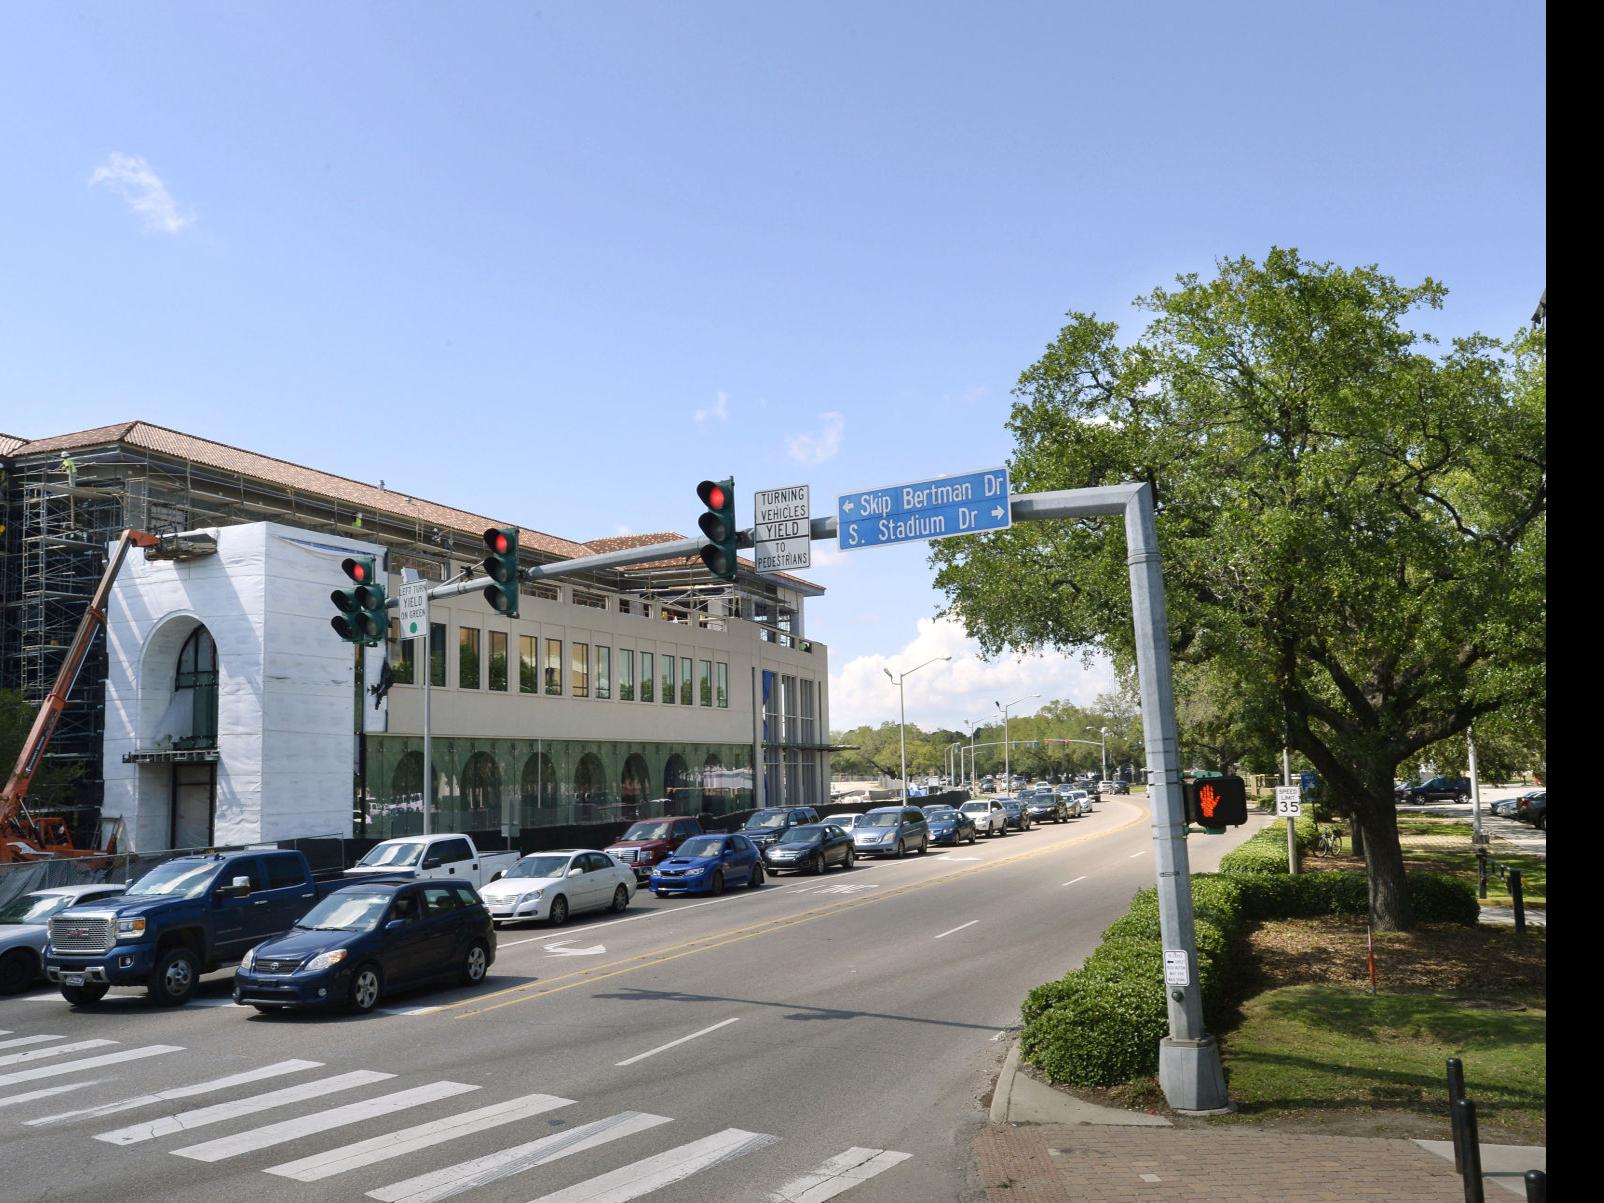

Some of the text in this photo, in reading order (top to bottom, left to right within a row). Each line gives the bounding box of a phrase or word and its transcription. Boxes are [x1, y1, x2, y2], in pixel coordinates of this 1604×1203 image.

[761, 487, 804, 506] TURNING
[860, 474, 1003, 518] Skip Bertman Dr
[761, 504, 806, 522] VEHICLES
[766, 521, 799, 539] YIELD
[848, 507, 978, 546] S. Stadium Dr
[775, 541, 786, 554] TO
[757, 552, 807, 569] PEDESTRIANS
[403, 595, 423, 608] YIELD
[400, 608, 427, 621] ON GREEN
[1279, 801, 1299, 813] 35
